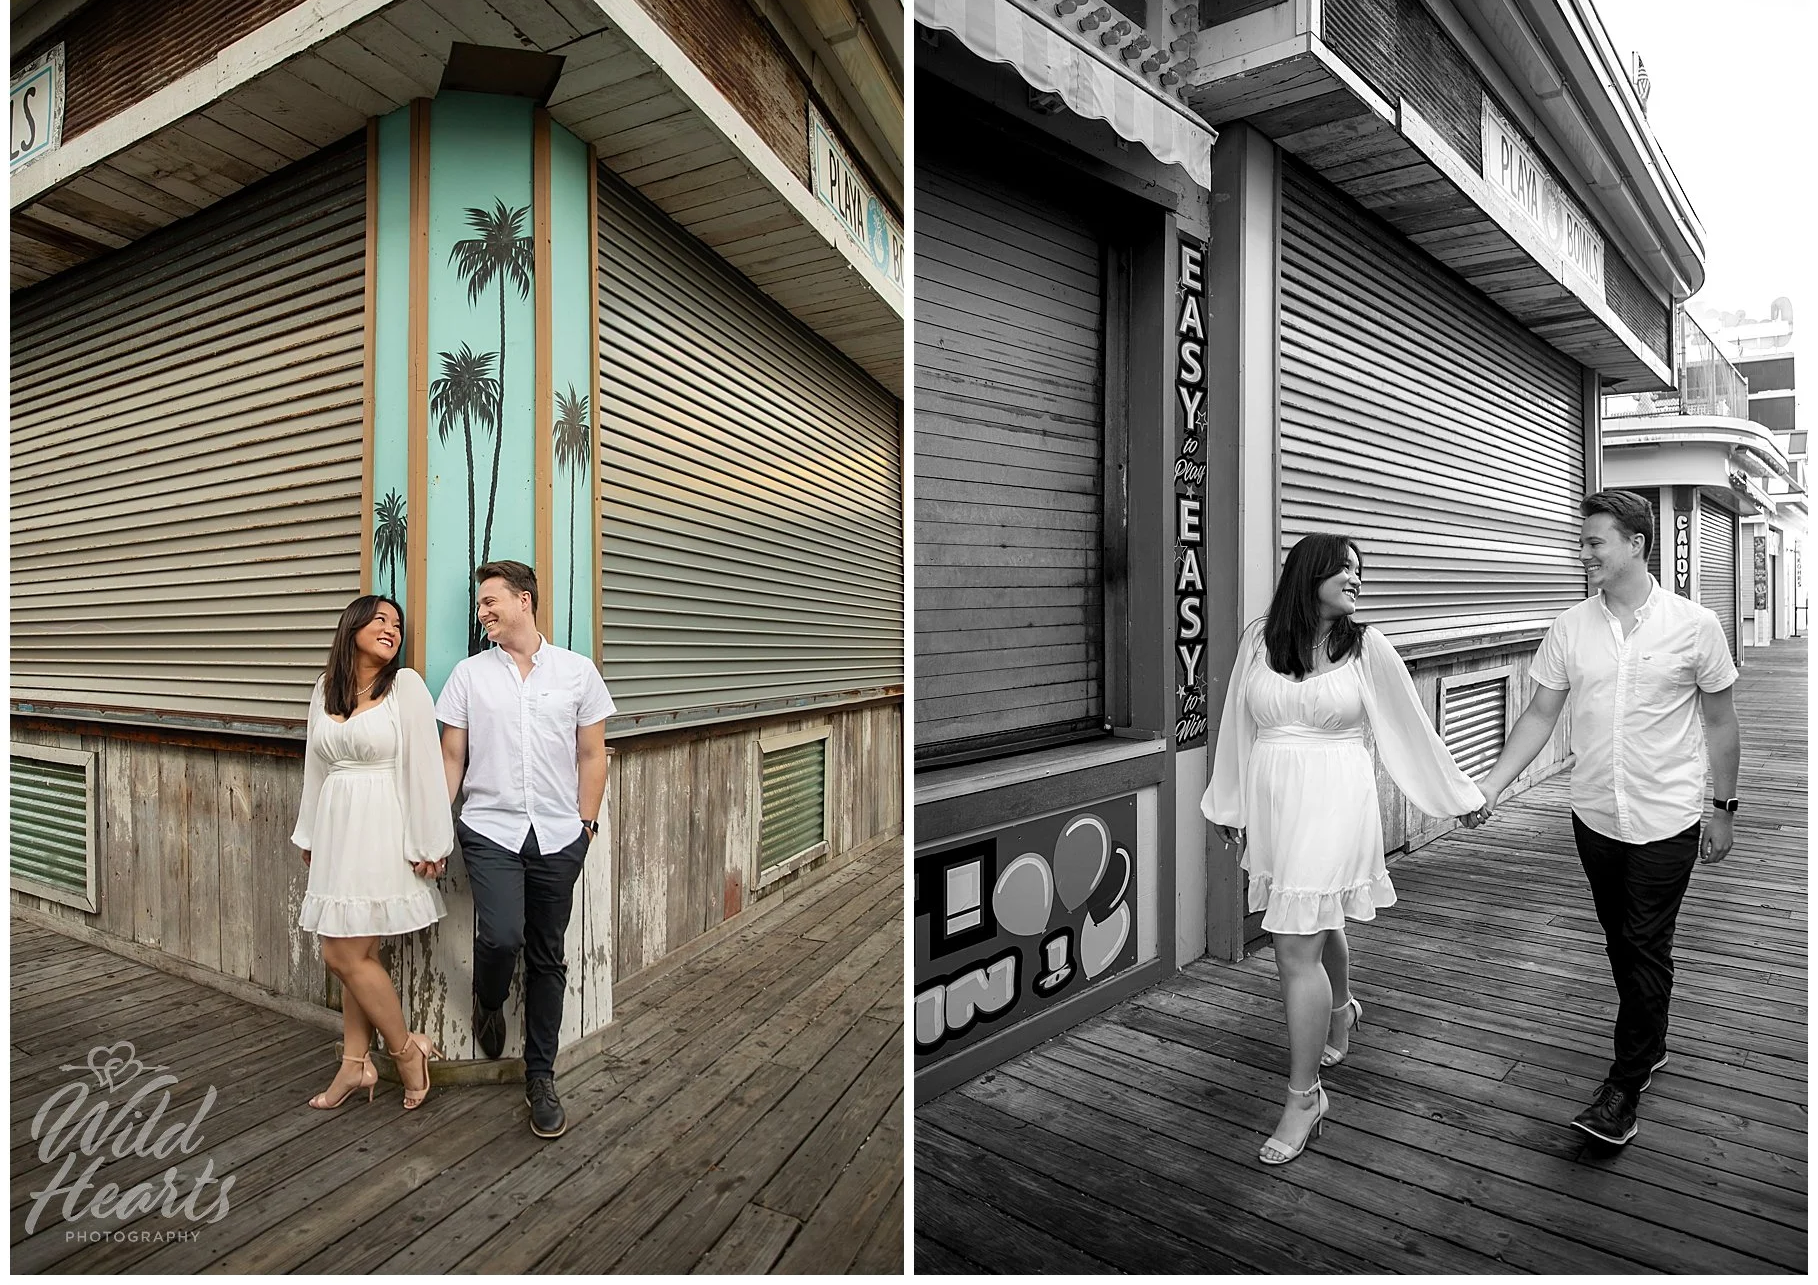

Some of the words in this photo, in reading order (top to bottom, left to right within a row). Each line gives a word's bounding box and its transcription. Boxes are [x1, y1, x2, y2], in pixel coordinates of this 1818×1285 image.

[828, 148, 865, 242] PLAYA
[1501, 135, 1539, 222] PLAYA
[1566, 212, 1599, 285] BOWLS
[1178, 244, 1205, 430] EASY
[1174, 459, 1207, 485] Play
[1182, 436, 1198, 454] to
[1676, 515, 1688, 588] CANDY
[1178, 499, 1204, 686] EASY
[1175, 713, 1208, 744] Win
[1183, 693, 1198, 712] to
